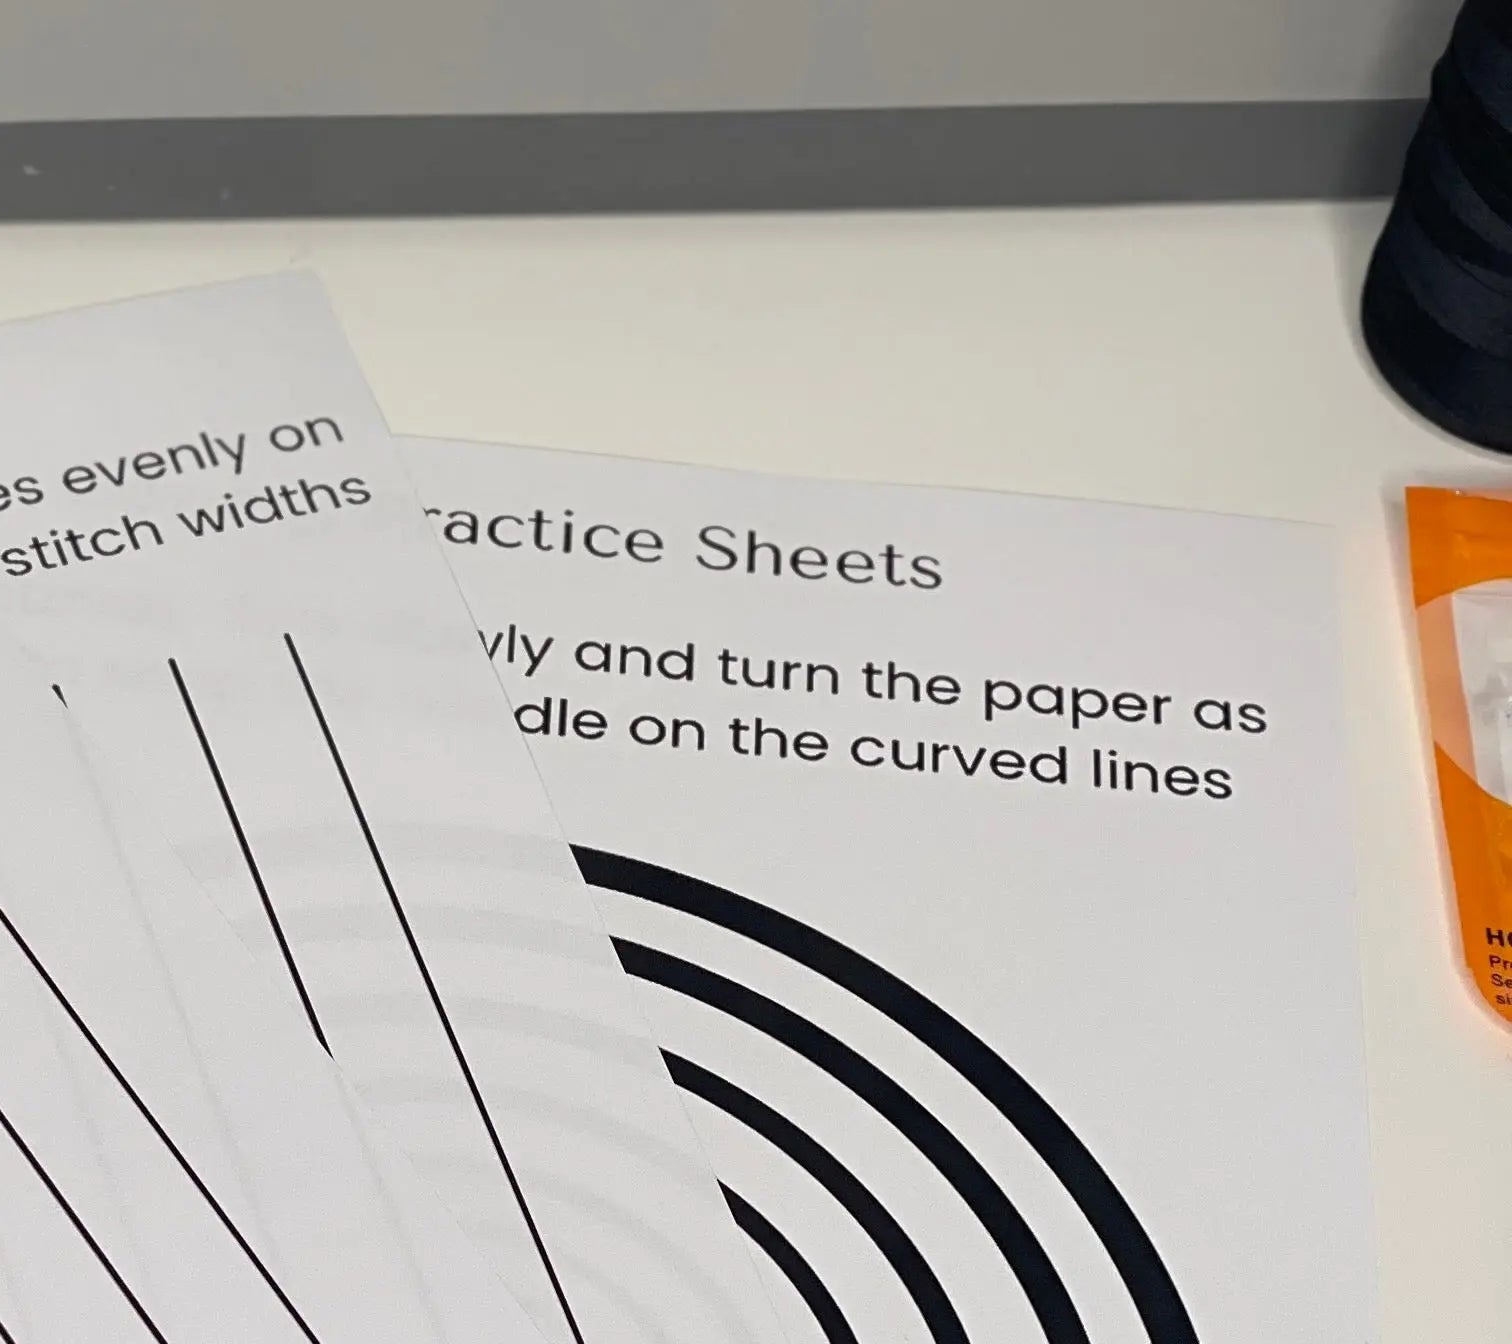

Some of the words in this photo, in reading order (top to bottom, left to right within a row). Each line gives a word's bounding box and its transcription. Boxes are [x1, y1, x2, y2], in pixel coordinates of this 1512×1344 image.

[62, 431, 246, 495] evenly
[269, 417, 344, 453] on
[0, 515, 166, 578] stitch
[175, 477, 373, 538] widths
[695, 525, 943, 590] Sheets
[574, 640, 695, 682] and
[717, 647, 839, 696] turn
[861, 660, 962, 706] the
[984, 678, 1172, 730] paper
[1193, 699, 1268, 734] as
[628, 715, 705, 751] on
[728, 716, 829, 762] the
[850, 736, 1068, 786] curved
[1092, 748, 1233, 800] lines
[1486, 927, 1512, 946] H
